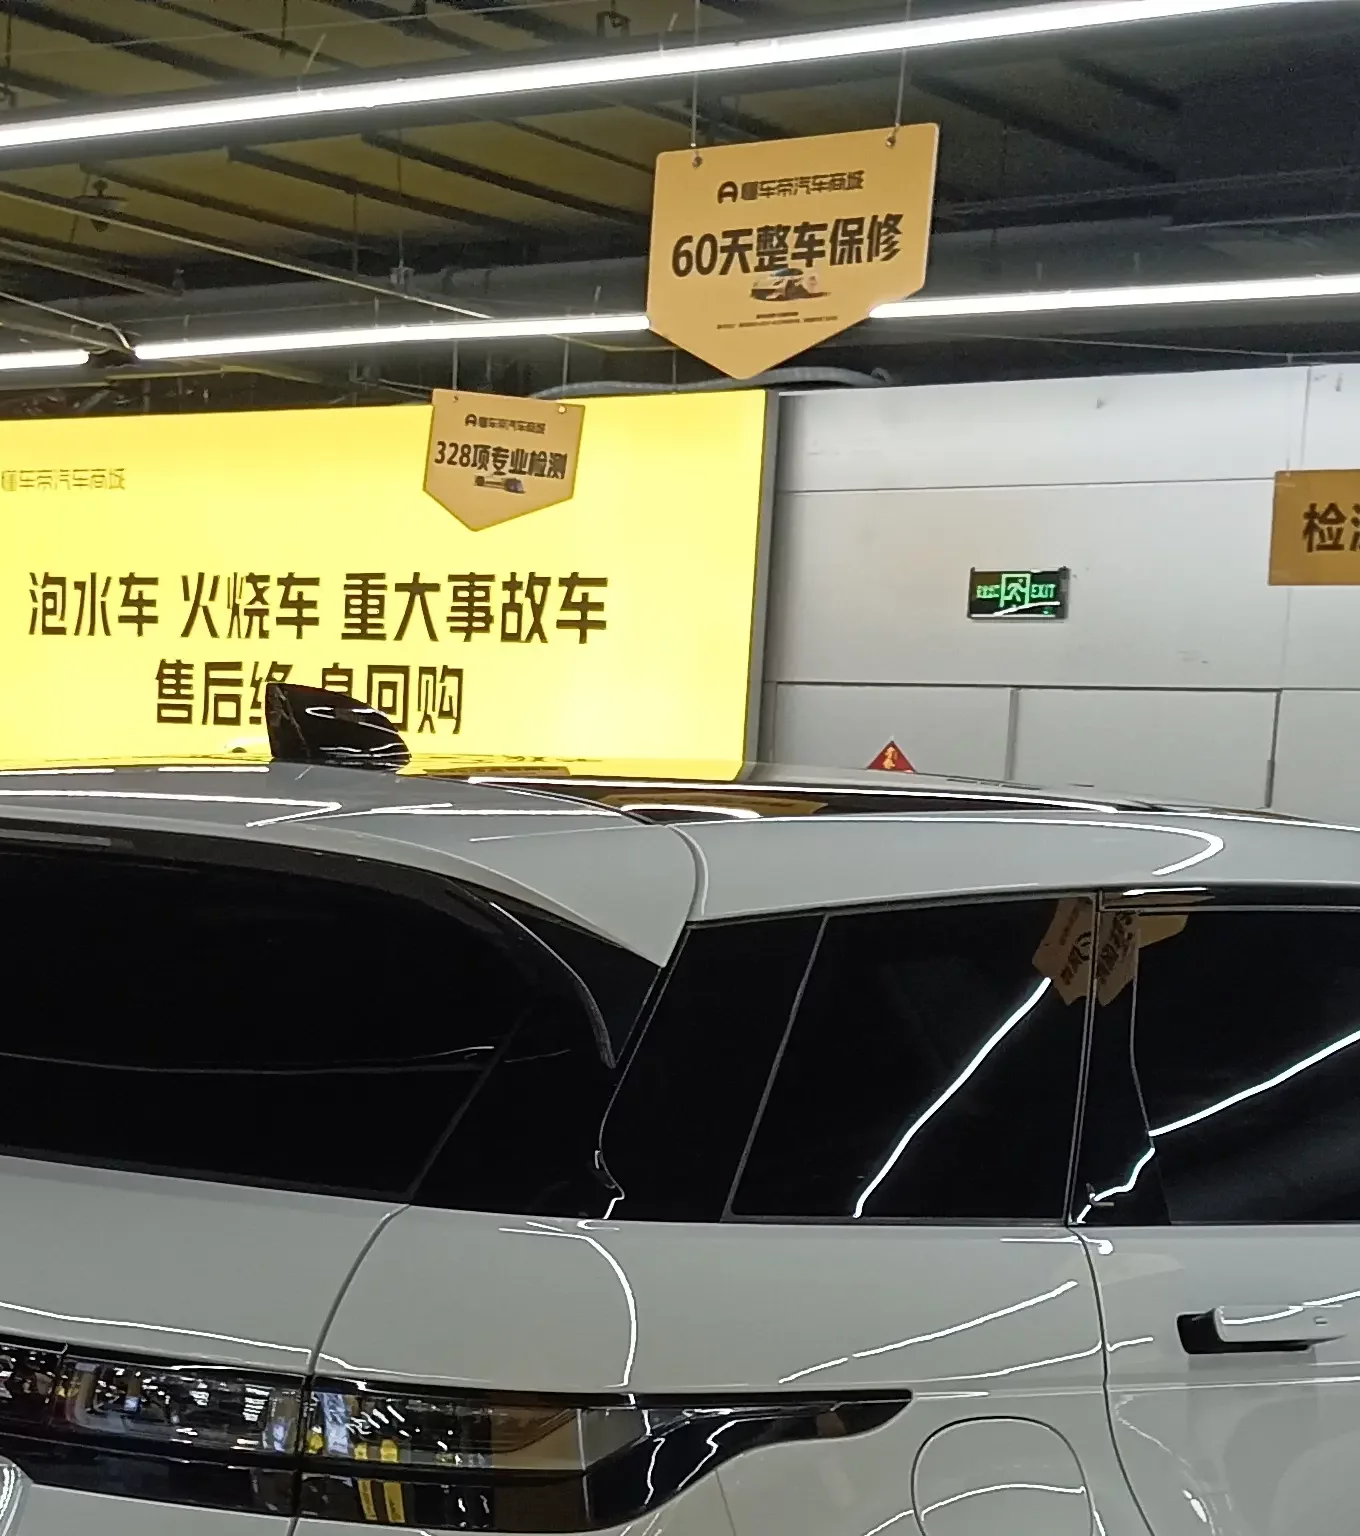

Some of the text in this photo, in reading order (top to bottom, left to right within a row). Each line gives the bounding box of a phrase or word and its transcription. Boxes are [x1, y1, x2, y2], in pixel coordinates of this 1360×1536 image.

[672, 213, 904, 277] 60天整车保修
[434, 440, 568, 479] 328项专业检测
[28, 571, 608, 644] 泡水车 火烧车 重大事故车
